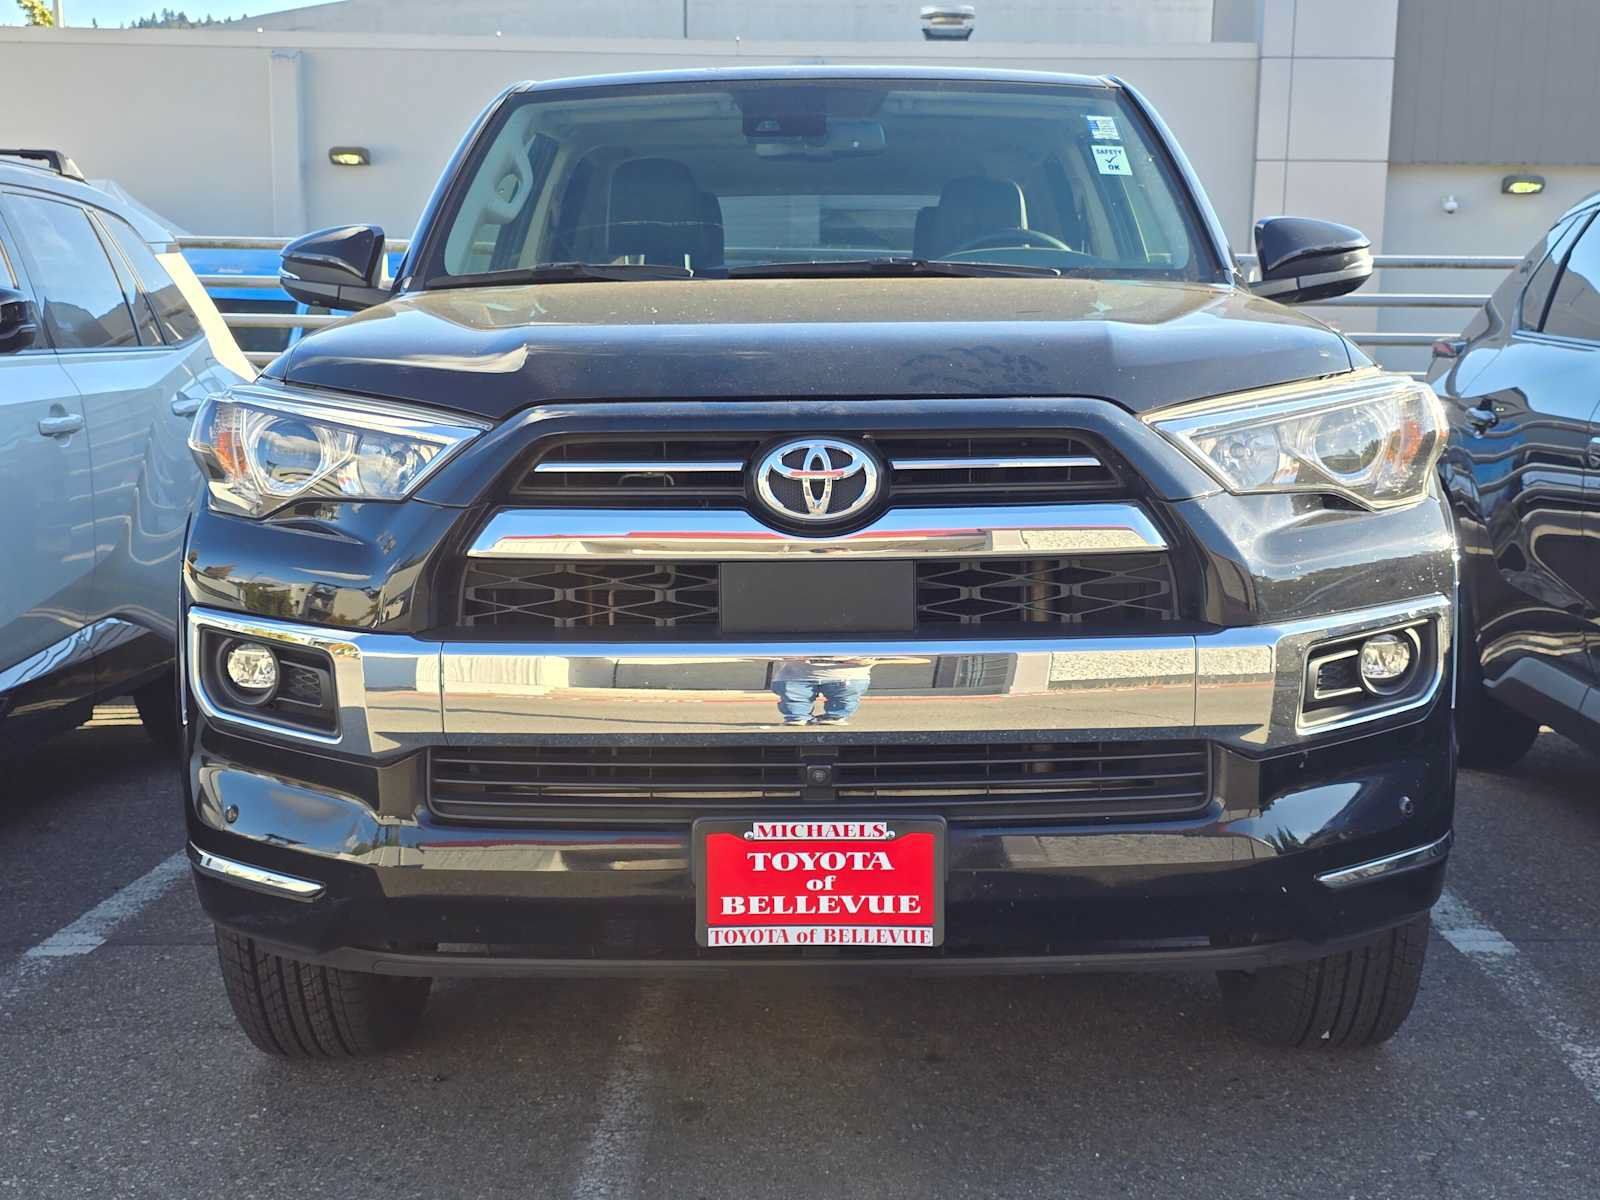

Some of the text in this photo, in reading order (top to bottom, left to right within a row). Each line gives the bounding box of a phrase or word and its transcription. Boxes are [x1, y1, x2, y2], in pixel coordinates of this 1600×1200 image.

[757, 824, 885, 838] MICHAELS
[747, 851, 895, 871] TOYOTA
[806, 875, 836, 891] of
[720, 895, 921, 915] BELLEVUE
[710, 928, 932, 945] TOYOTA of BELLEVUE
